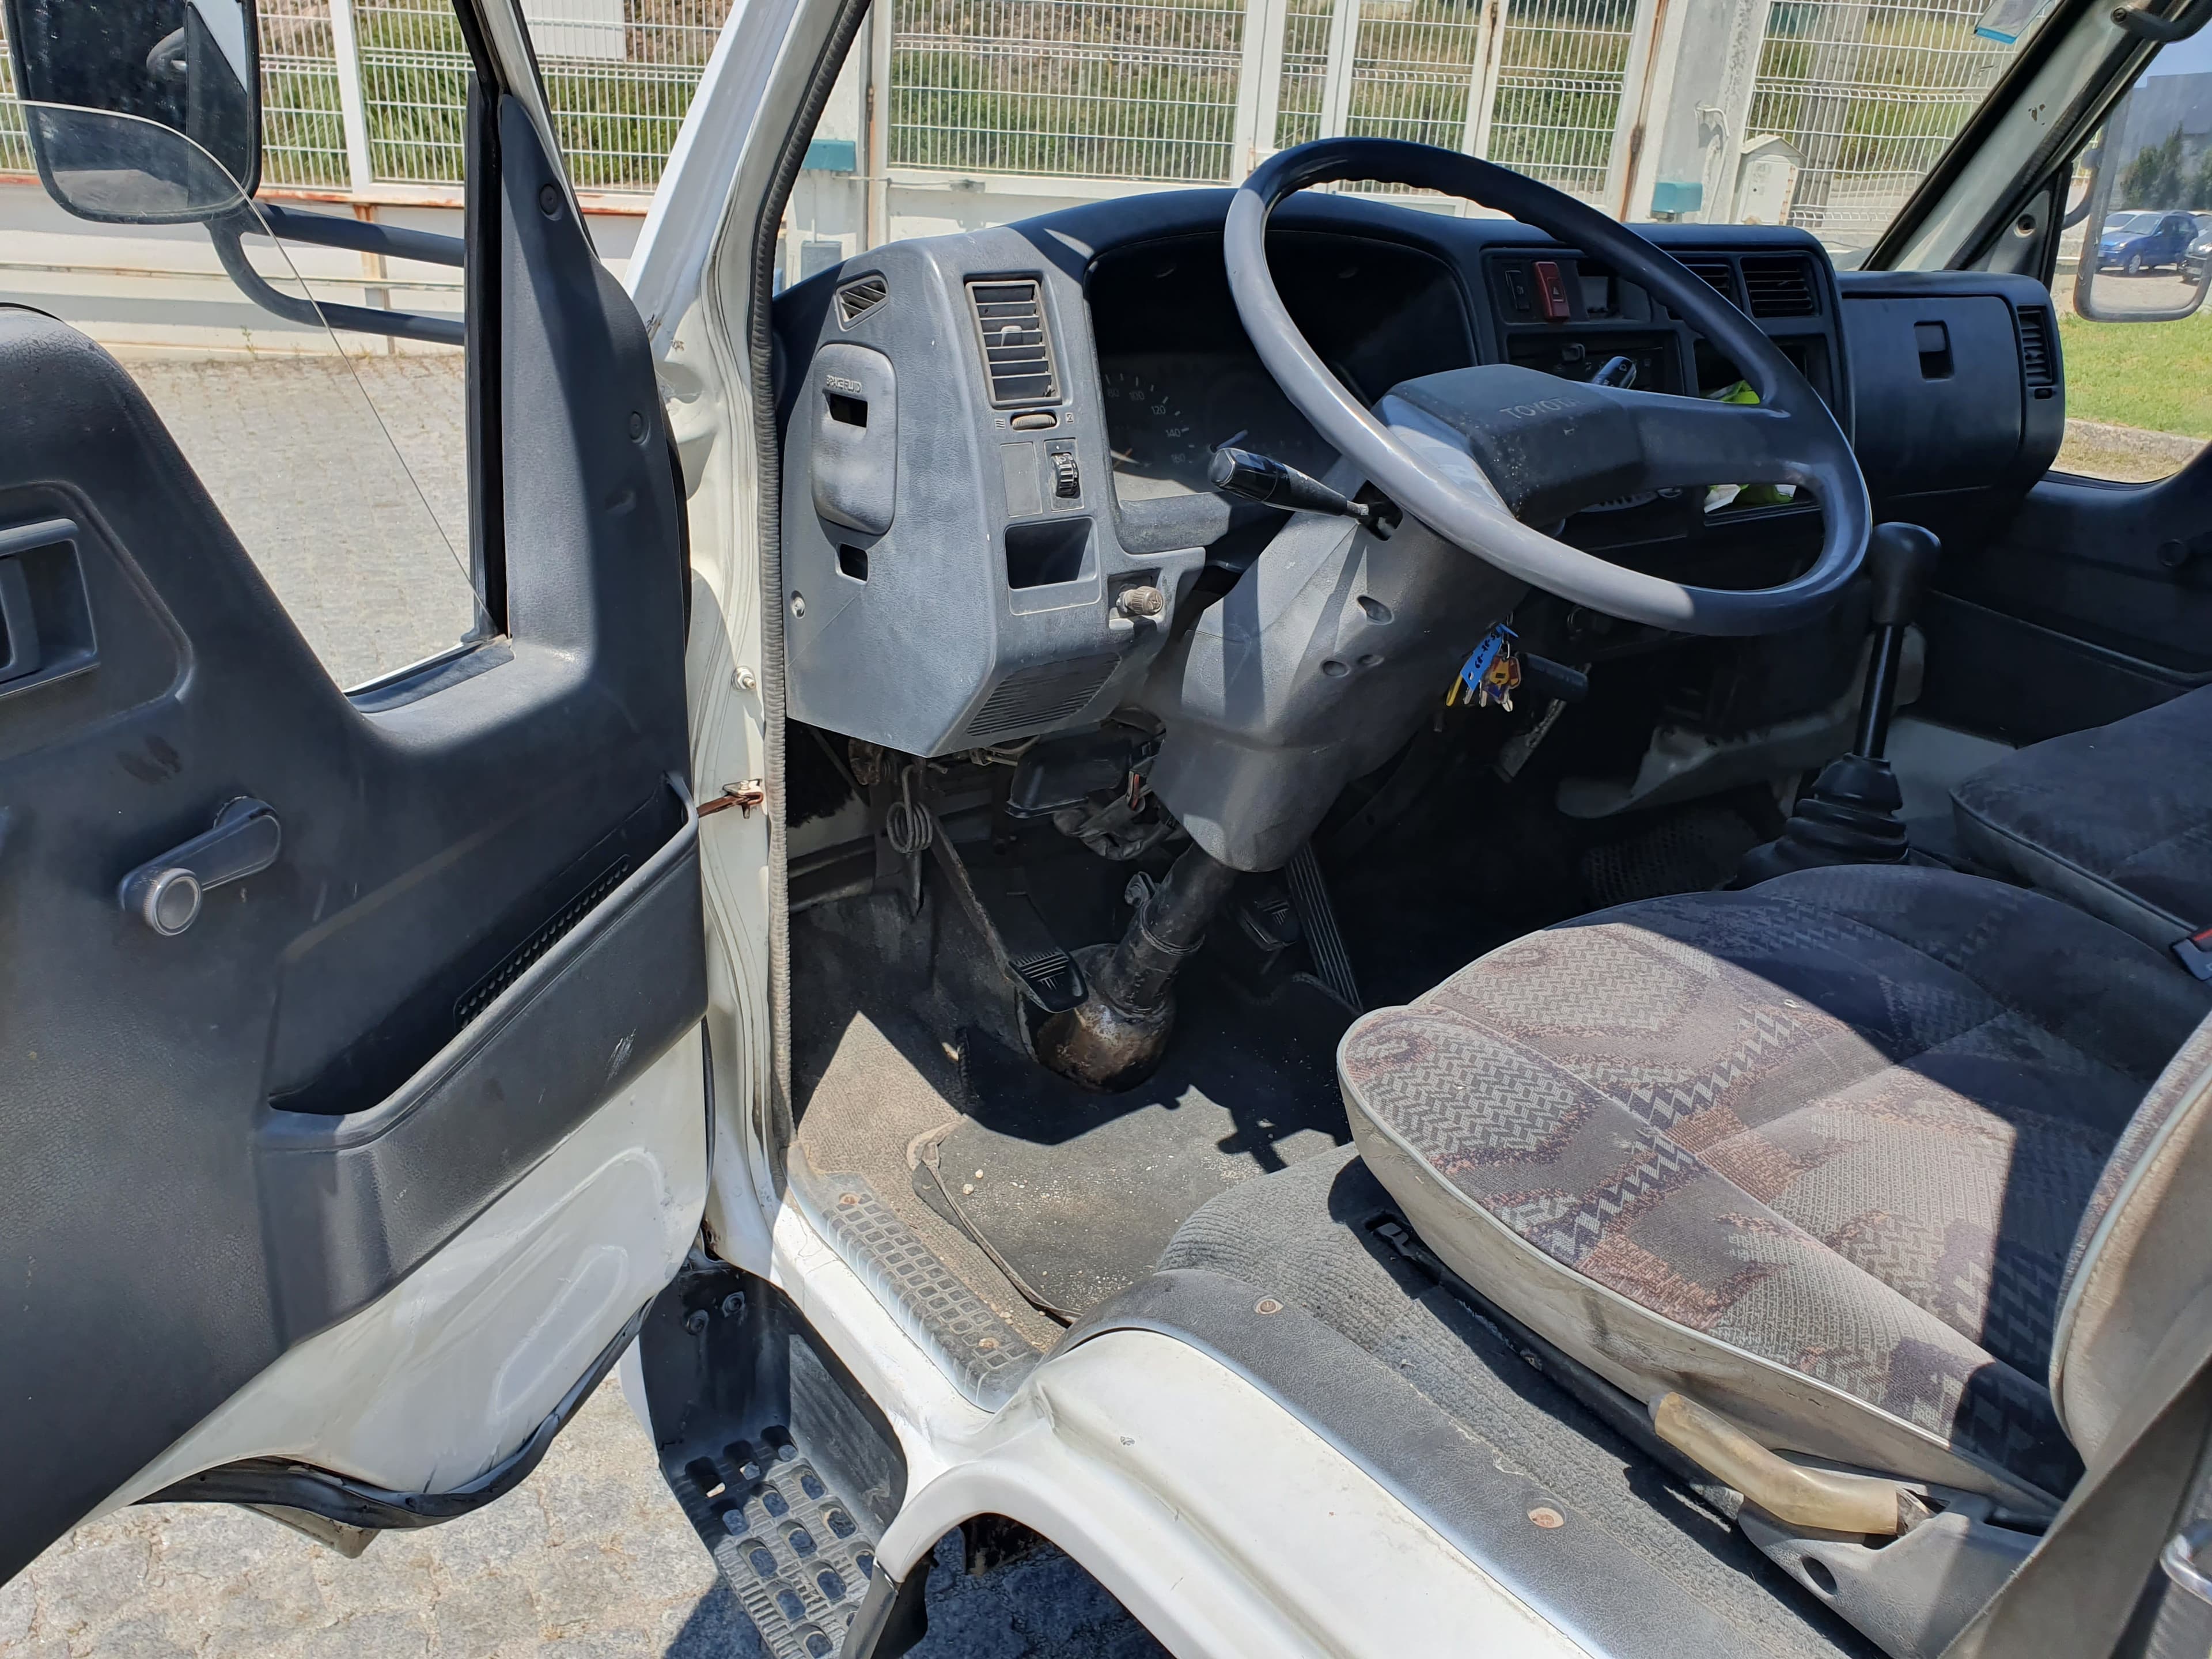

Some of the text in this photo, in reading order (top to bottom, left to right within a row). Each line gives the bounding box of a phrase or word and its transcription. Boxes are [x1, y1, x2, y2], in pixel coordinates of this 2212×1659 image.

[1129, 391, 1145, 400] 100
[1151, 405, 1166, 415] 120
[1499, 397, 1581, 419] TOYOTA
[1165, 428, 1181, 437] 140
